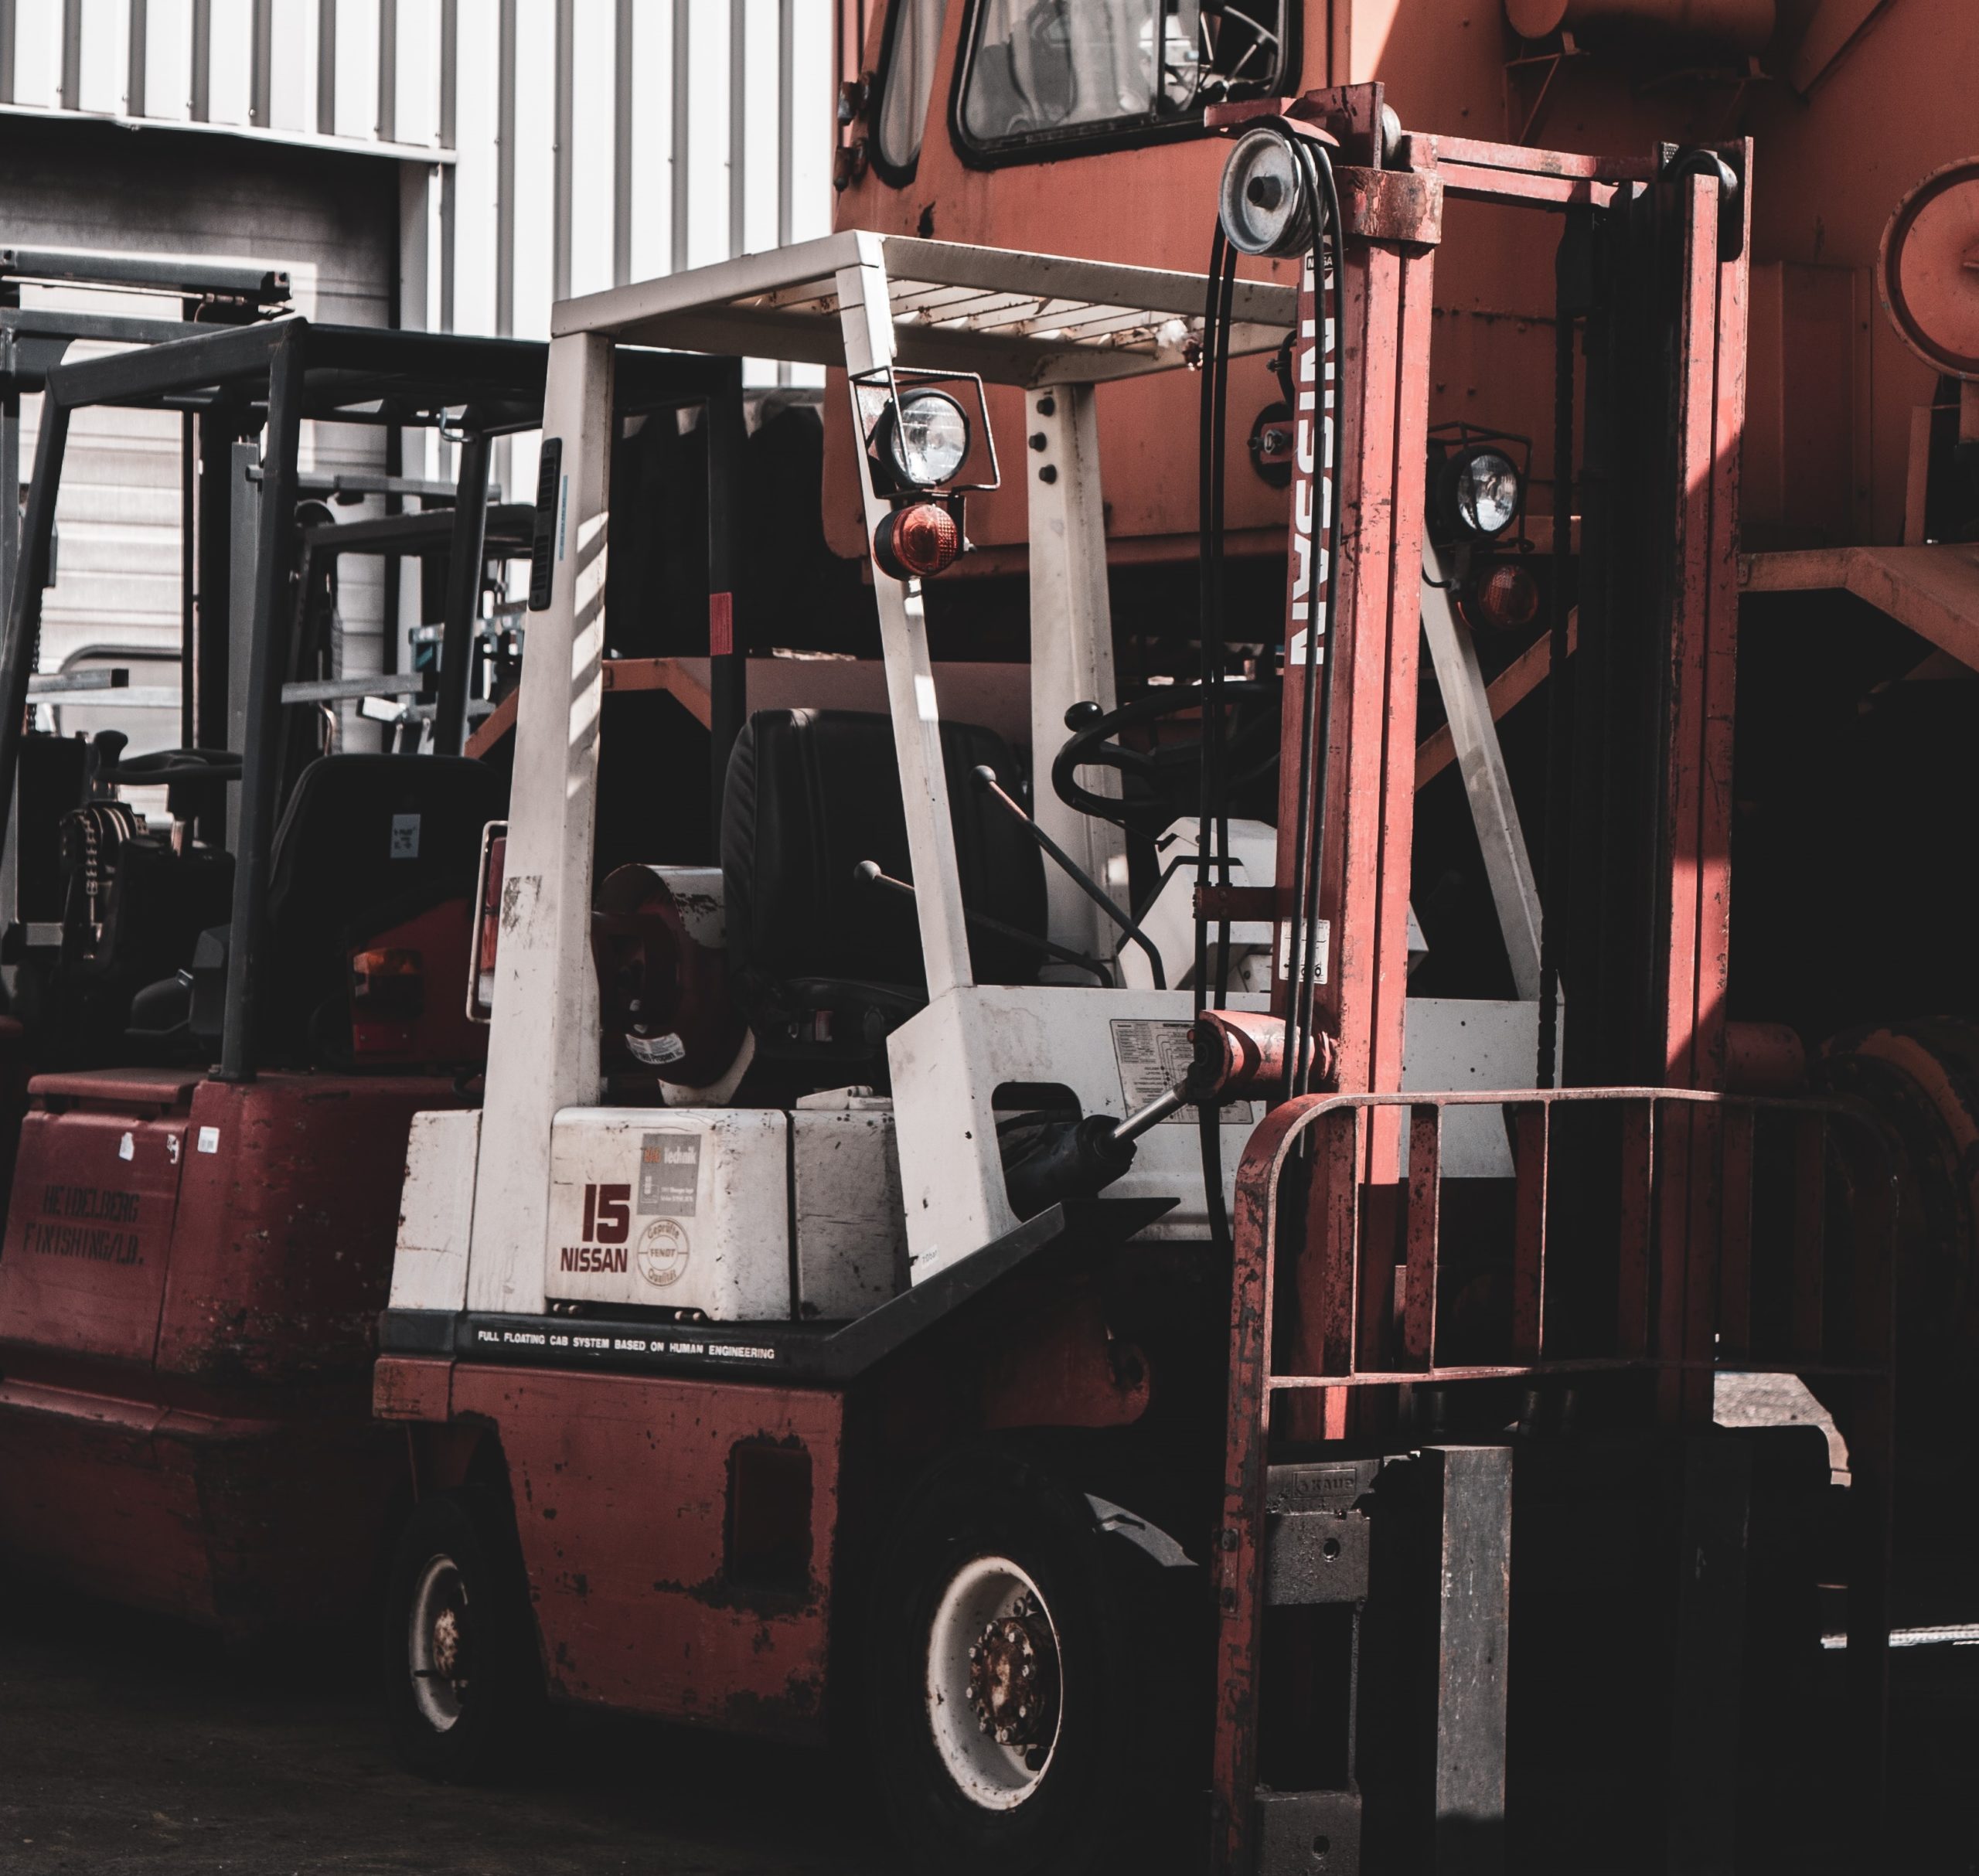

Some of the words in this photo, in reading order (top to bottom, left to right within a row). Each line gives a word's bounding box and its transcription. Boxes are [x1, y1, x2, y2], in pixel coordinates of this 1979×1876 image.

[1290, 318, 1336, 665] NISSAN
[43, 1185, 140, 1223] HEIDELBERG
[582, 1183, 631, 1244] 15
[560, 1247, 628, 1273] NISSAN
[478, 1330, 499, 1342] FULL
[504, 1332, 546, 1345] FLOATING
[550, 1335, 568, 1347] CAB
[573, 1336, 609, 1349] SYSTEM
[614, 1339, 646, 1351] BASED
[650, 1341, 664, 1352] ON
[669, 1342, 703, 1354] HUMAN
[708, 1345, 775, 1360] ENGINEERING
